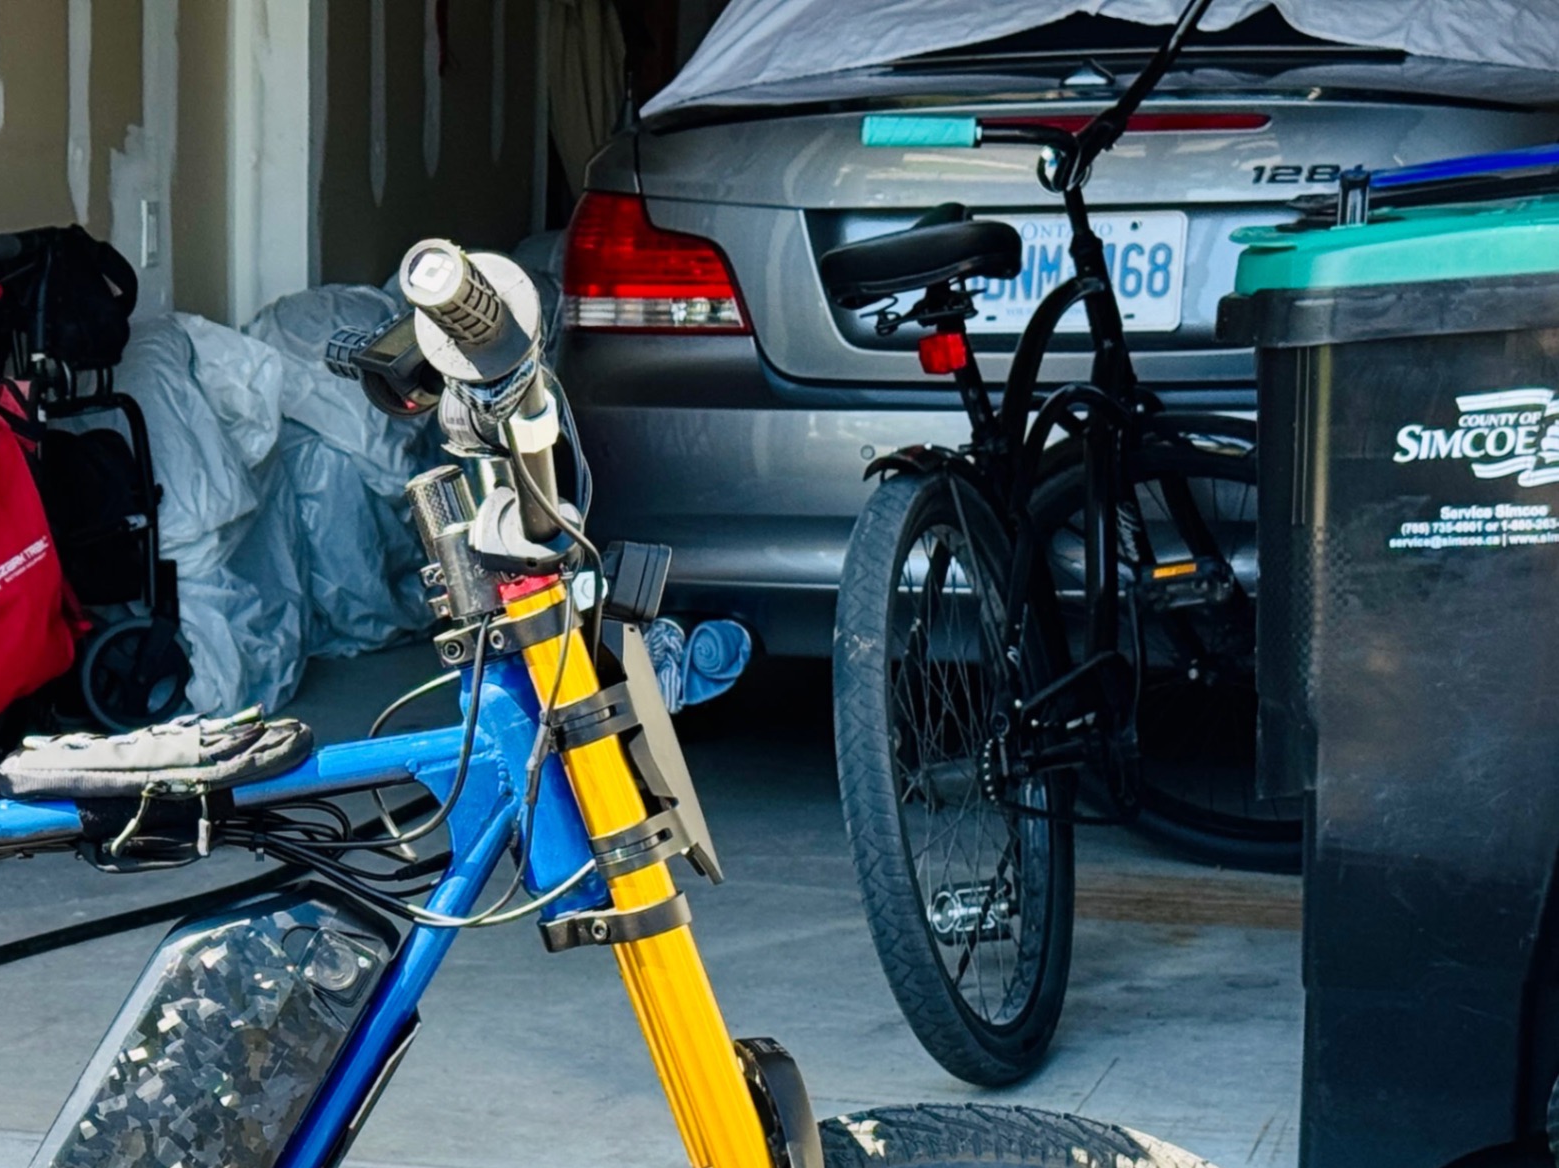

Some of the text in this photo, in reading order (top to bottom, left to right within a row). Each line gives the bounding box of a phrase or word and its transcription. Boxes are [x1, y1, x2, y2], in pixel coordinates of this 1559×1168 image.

[1458, 411, 1542, 427] COUNTY OF
[1392, 424, 1540, 463] SIMCOE
[1440, 504, 1551, 520] Service Simcoe
[1484, 521, 1499, 533] or
[1389, 534, 1501, 549] service@simcoe.ca
